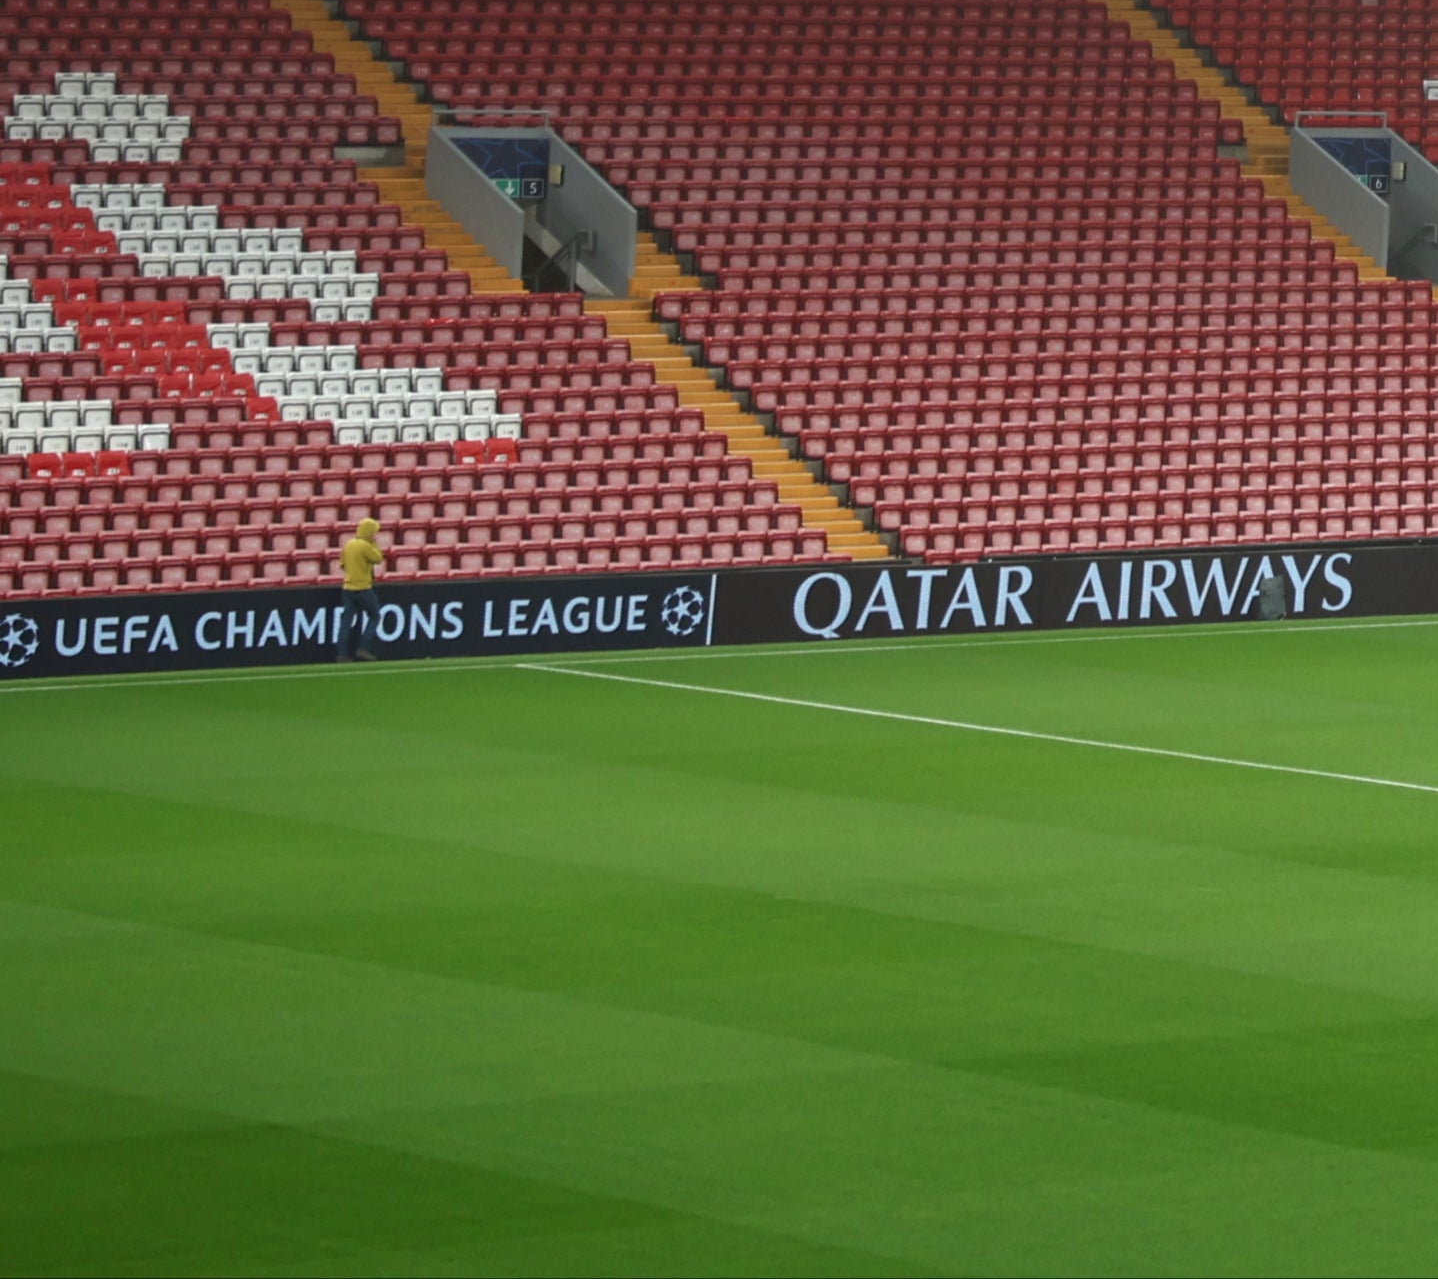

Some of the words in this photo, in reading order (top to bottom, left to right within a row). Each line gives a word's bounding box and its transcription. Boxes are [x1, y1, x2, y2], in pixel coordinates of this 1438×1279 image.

[529, 182, 536, 195] 5
[1376, 179, 1383, 189] 6
[793, 564, 1033, 640] QATAR
[1066, 552, 1353, 624] AIRWAYS
[54, 614, 180, 657] UEFA
[482, 594, 649, 639] LEAGUE
